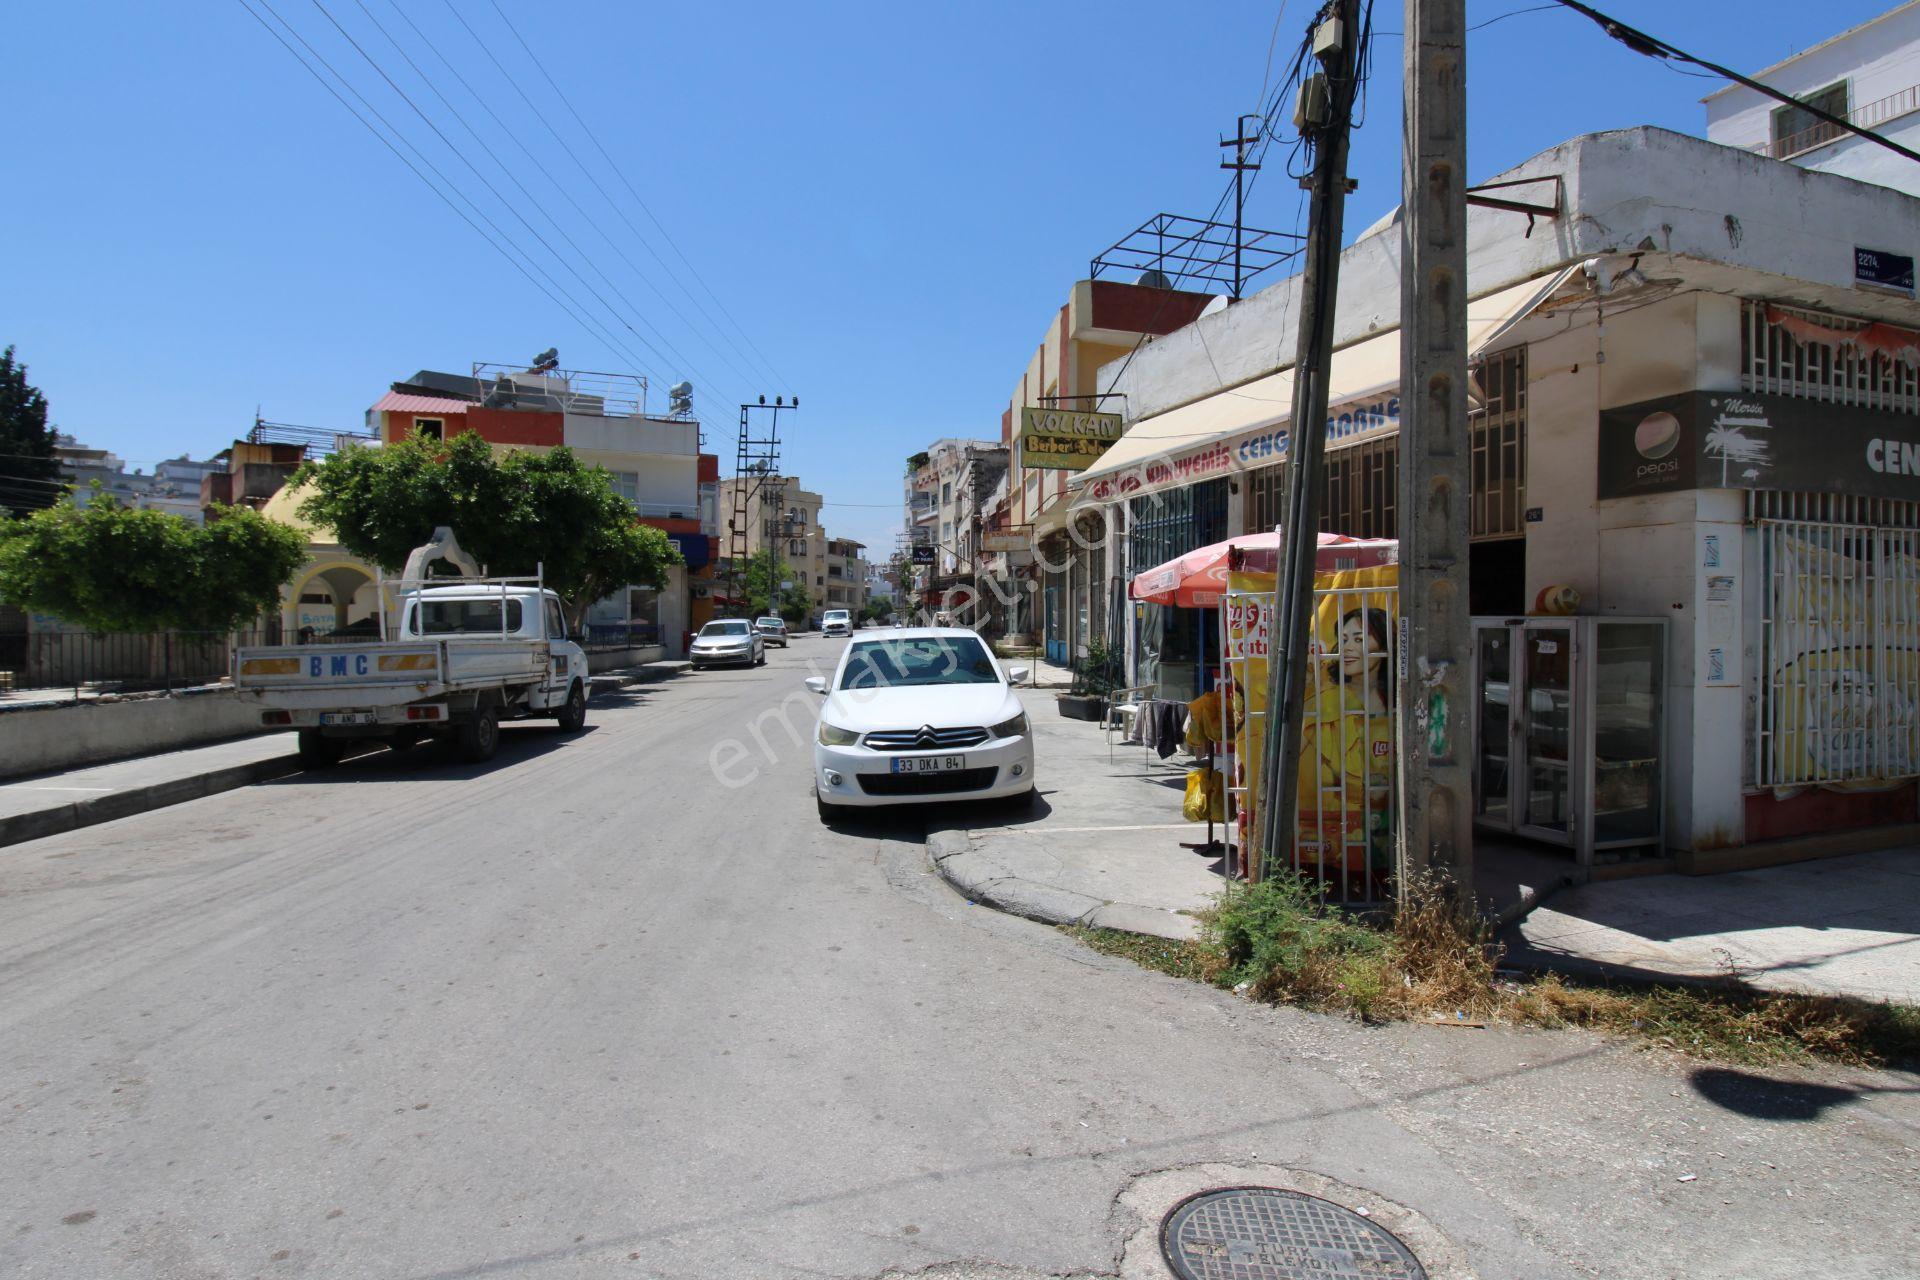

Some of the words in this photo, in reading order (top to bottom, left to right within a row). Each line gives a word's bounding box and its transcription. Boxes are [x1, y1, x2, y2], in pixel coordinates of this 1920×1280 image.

[1724, 398, 1764, 414] Mersin
[1030, 413, 1115, 437] VOLKAN
[1027, 434, 1070, 453] Berber
[1239, 429, 1289, 462] CENG
[1636, 458, 1680, 479] pepsi
[310, 655, 368, 678] BMC
[900, 759, 913, 771] 33
[919, 758, 939, 771] DKA
[946, 757, 959, 769] 84
